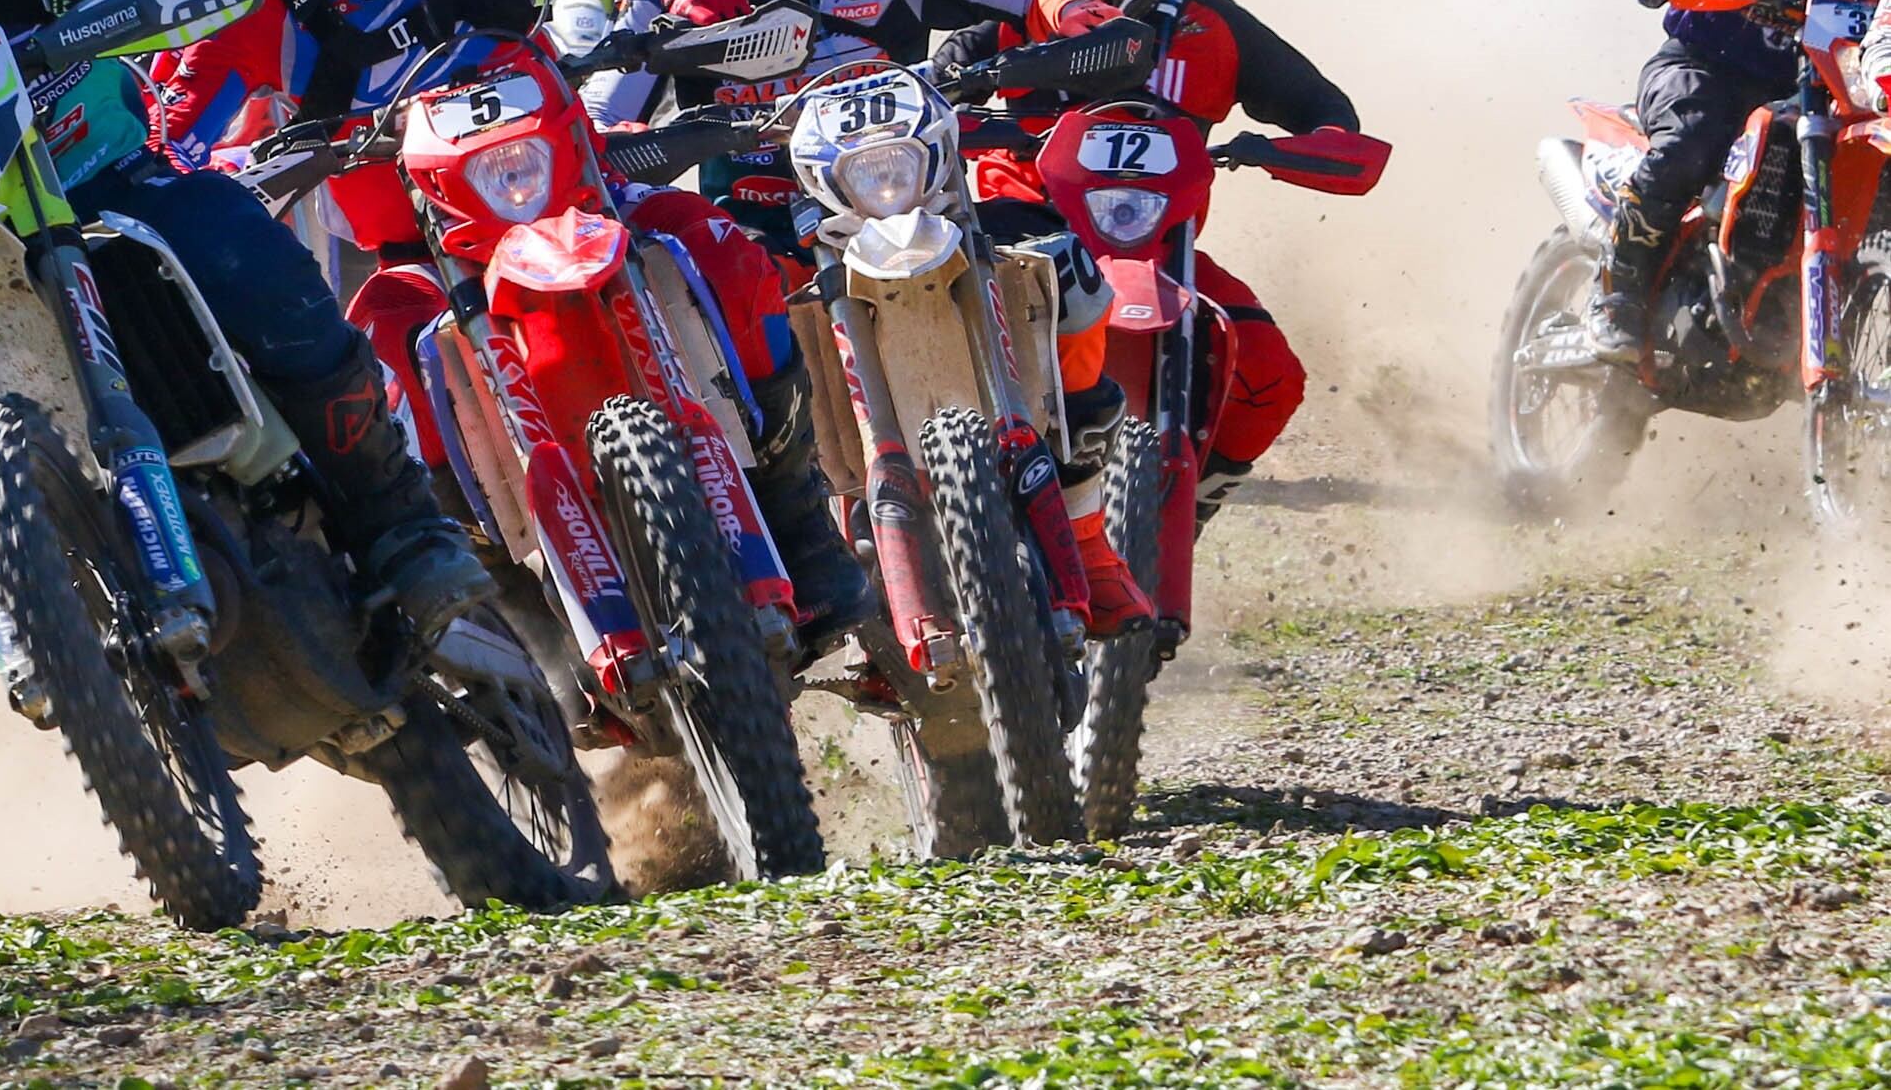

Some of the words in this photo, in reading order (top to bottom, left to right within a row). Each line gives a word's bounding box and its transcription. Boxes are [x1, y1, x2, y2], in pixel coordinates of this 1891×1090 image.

[59, 5, 139, 48] Husqvarna
[836, 4, 878, 20] NACEX
[469, 85, 501, 126] 5
[839, 91, 897, 133] 30
[1105, 131, 1151, 170] 12
[690, 434, 742, 537] BORILLI
[119, 475, 169, 571] MICHELIN
[150, 472, 192, 557] MOTOREX
[555, 503, 624, 598] BORILLI
